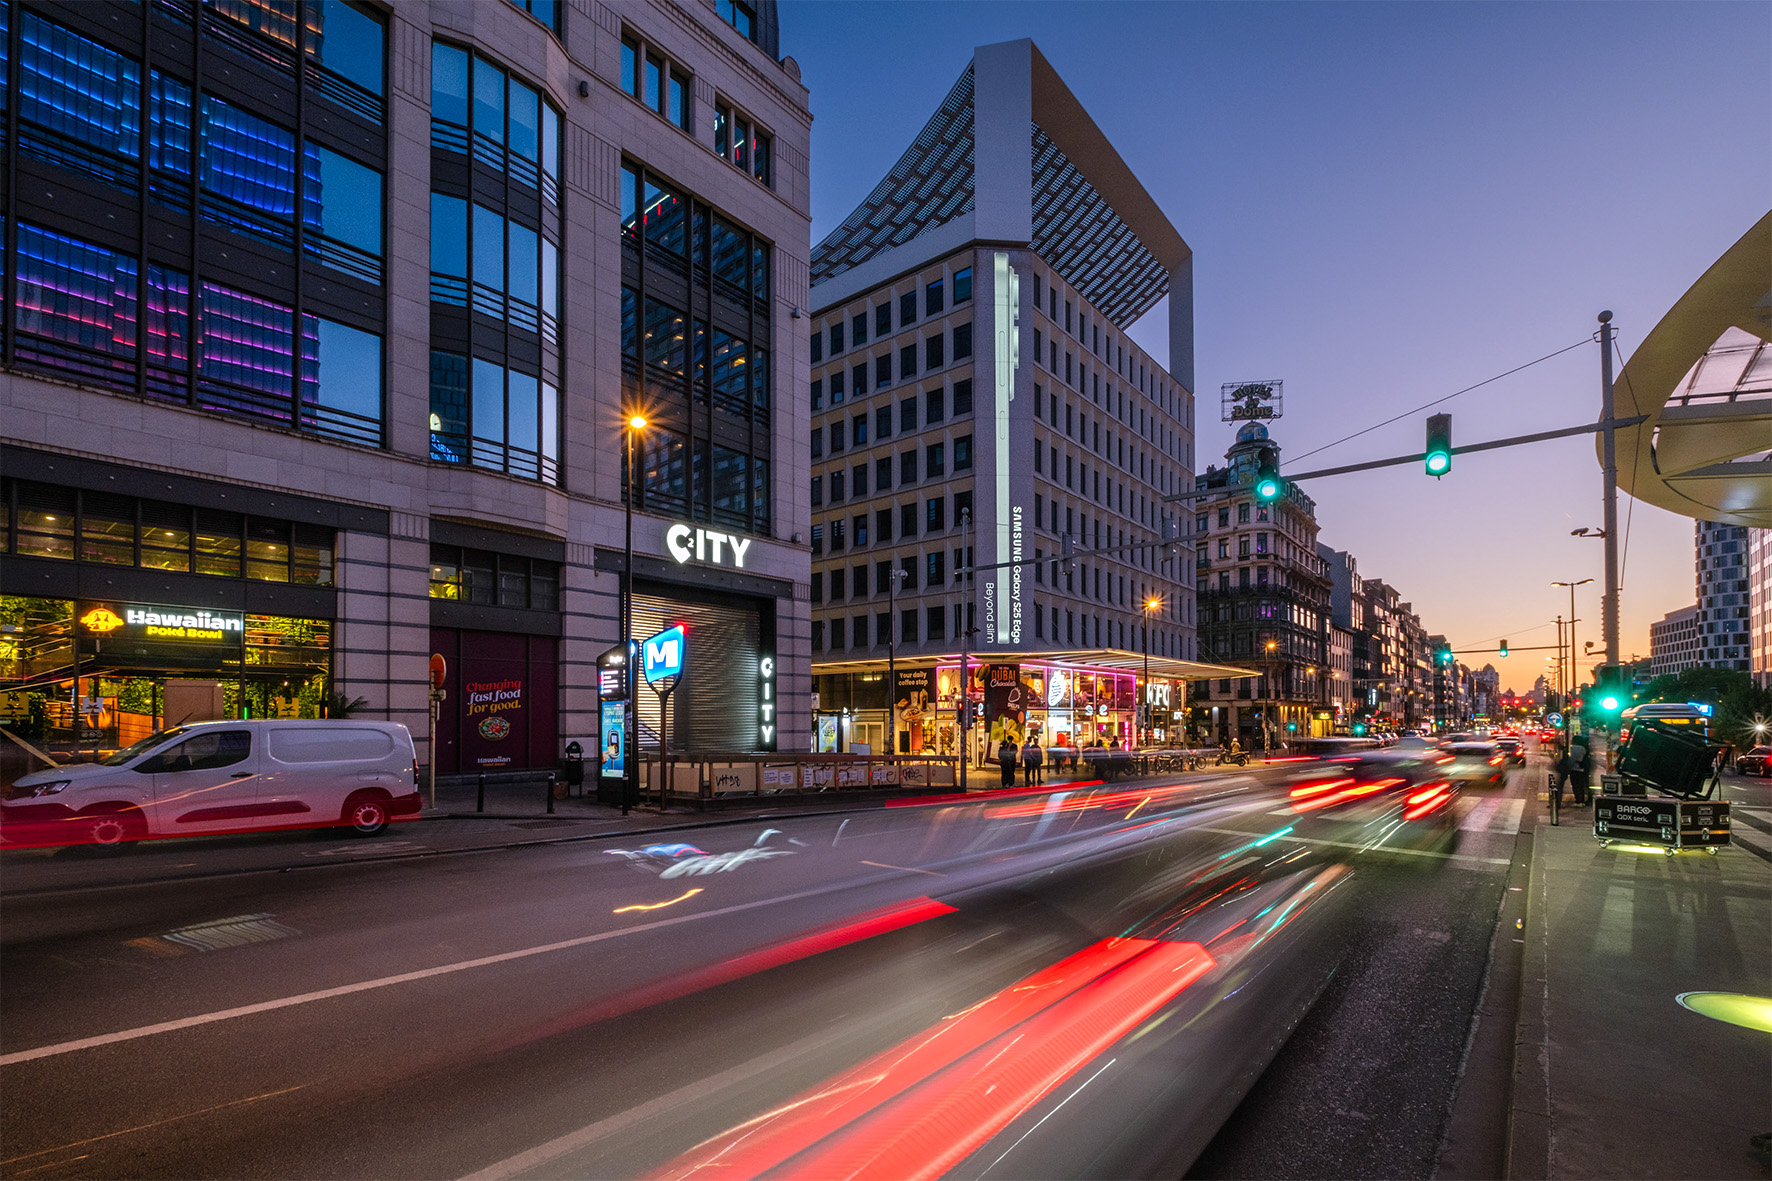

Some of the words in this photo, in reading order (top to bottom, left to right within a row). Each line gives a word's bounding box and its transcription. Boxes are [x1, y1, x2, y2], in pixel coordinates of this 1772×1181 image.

[1232, 384, 1272, 401] HOTEL
[1012, 506, 1022, 562] SAMSUNG
[1011, 565, 1022, 601] Galaxy
[984, 582, 995, 622] Beyond
[1013, 602, 1022, 619] S25
[127, 609, 241, 631] Hawaiian
[147, 625, 186, 637] Poké
[187, 628, 223, 639] Bowl
[986, 622, 995, 644] slim
[1011, 619, 1022, 644] Edge
[647, 640, 678, 669] M
[898, 679, 915, 687] coffee
[916, 679, 929, 687] stop
[913, 670, 928, 680] daily
[991, 669, 1016, 681] DUBAI
[466, 679, 521, 692] Changing
[467, 691, 494, 705] fast
[492, 689, 521, 702] food
[1146, 683, 1171, 706] KFC
[466, 703, 488, 716] for
[489, 699, 521, 713] good.
[477, 755, 511, 764] Hawaiian
[1616, 804, 1652, 815] BARCO
